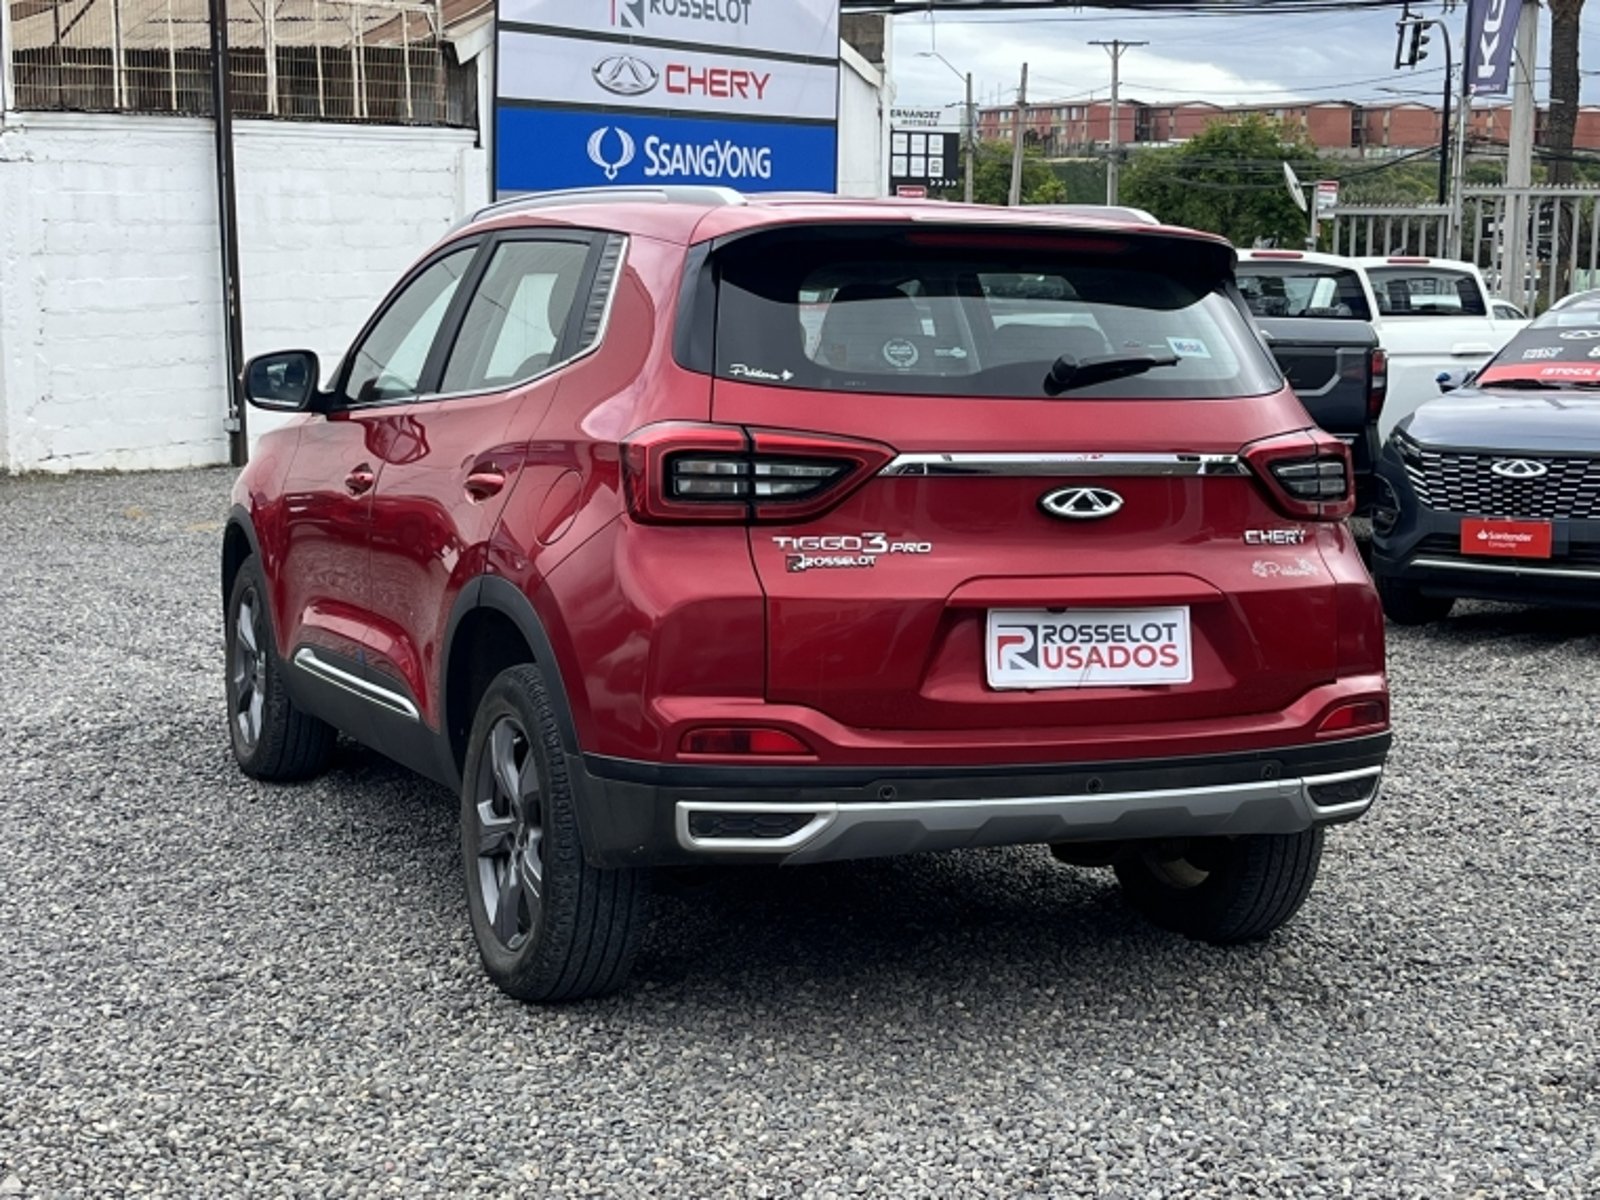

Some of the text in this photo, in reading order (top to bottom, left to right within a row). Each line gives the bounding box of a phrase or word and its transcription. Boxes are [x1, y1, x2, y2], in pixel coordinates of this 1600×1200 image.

[665, 64, 771, 100] CHERY
[1244, 529, 1306, 544] CHERY
[1488, 530, 1534, 542] Santander
[890, 542, 932, 553] PRO
[804, 554, 877, 567] ROSSELOT
[1042, 622, 1178, 645] ROSSELOT
[1042, 644, 1180, 671] USADOS
